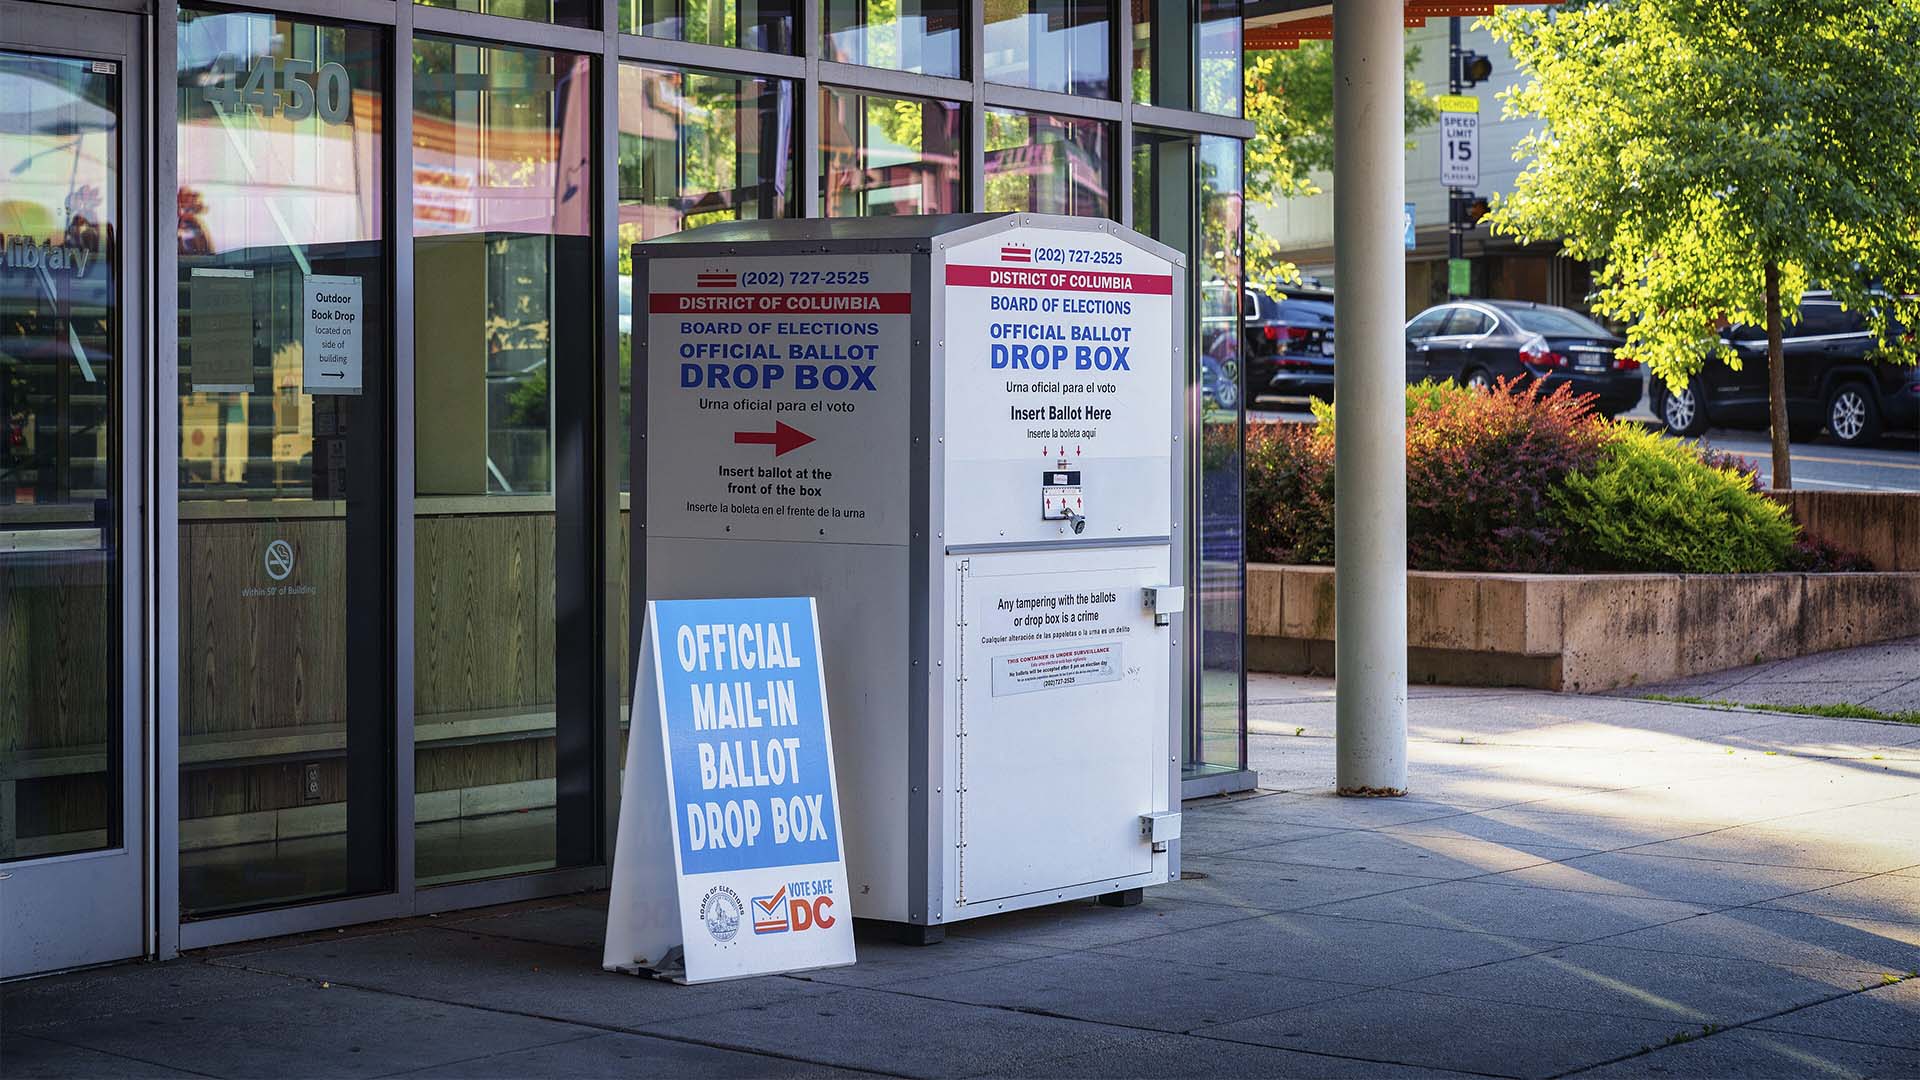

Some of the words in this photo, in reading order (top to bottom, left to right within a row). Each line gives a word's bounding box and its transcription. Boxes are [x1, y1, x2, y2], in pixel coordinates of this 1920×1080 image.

[203, 51, 351, 126] 4450
[1444, 117, 1476, 128] SPEED
[1447, 128, 1472, 138] LIMIT
[1448, 140, 1472, 161] 15
[7, 234, 89, 278] library
[1034, 247, 1065, 264] (202)
[1068, 249, 1122, 265] 727-2525
[742, 271, 785, 288] (202)
[790, 271, 869, 285] 727-2525
[990, 270, 1047, 286] DISTRICT
[1050, 273, 1066, 287] OF
[1069, 274, 1132, 290] COLUMBIA
[316, 292, 351, 304] Outdoor
[679, 296, 755, 310] DISTRICT
[759, 297, 782, 310] OF
[786, 296, 881, 310] COLUMBIA
[990, 295, 1038, 312] BOARD
[1042, 297, 1059, 313] OF
[1063, 298, 1131, 315] ELECTIONS
[311, 309, 332, 320] Book
[335, 310, 355, 323] Drop
[315, 325, 340, 335] located
[342, 327, 351, 335] on
[680, 322, 742, 335] BOARD
[748, 322, 772, 335] OF
[777, 322, 879, 336] ELECTIONS
[990, 323, 1065, 341] OFFICIAL
[1071, 325, 1132, 342] BALLOT
[322, 340, 336, 349] side
[337, 340, 345, 349] of
[680, 343, 781, 360] OFFICIAL
[789, 344, 879, 361] BALLOT
[320, 354, 348, 365] building
[991, 343, 1068, 370] DROP
[1075, 345, 1130, 371] BOX
[680, 363, 785, 390] DROP
[795, 364, 877, 391] BOX
[1006, 381, 1029, 393] Urna
[1031, 381, 1060, 393] oficial
[1062, 383, 1084, 395] para
[1086, 382, 1095, 393] el
[1097, 383, 1116, 393] voto
[699, 398, 729, 411] Urna
[733, 398, 772, 411] oficial
[776, 401, 806, 414] para
[810, 399, 822, 412] el
[826, 401, 855, 413] voto
[1011, 405, 1045, 421] Insert
[1049, 405, 1082, 420] Ballot
[1085, 405, 1112, 420] Here
[1027, 428, 1051, 439] Inserte
[1051, 428, 1058, 439] la
[1059, 427, 1080, 439] boleta
[1081, 427, 1096, 440] aquí
[719, 465, 754, 478] Insert
[758, 466, 792, 479] ballot
[796, 468, 808, 479] at
[812, 468, 832, 480] the
[727, 482, 756, 494] front
[760, 482, 773, 495] of
[776, 484, 796, 496] the
[799, 484, 822, 497] box
[687, 502, 718, 513] Inserte
[720, 502, 729, 513] la
[731, 503, 760, 514] boleta
[762, 506, 774, 515] en
[776, 504, 785, 515] el
[787, 505, 815, 517] frente
[817, 506, 829, 517] de
[832, 507, 840, 518] la
[843, 509, 865, 518] urna
[997, 598, 1014, 613] Any
[1016, 595, 1056, 610] tampering
[1058, 594, 1075, 606] with
[1076, 593, 1089, 605] the
[1091, 591, 1116, 604] ballots
[1013, 616, 1022, 627] or
[1024, 613, 1043, 627] drop
[1045, 612, 1060, 624] box
[1061, 612, 1069, 623] is
[1071, 613, 1076, 622] a
[1077, 610, 1099, 622] crime
[677, 622, 801, 672] OFFICIAL
[1007, 656, 1019, 664] THIS
[1020, 654, 1049, 663] CONTAINER
[1056, 651, 1073, 659] UNDER
[1074, 647, 1110, 657] SURVEILLANCE
[690, 680, 798, 731] MAIL-IN
[698, 738, 801, 791] BALLOT
[686, 799, 761, 851] DROP
[770, 794, 828, 844] BOX
[788, 881, 811, 898] VOTE
[812, 879, 834, 896] SAFE
[700, 893, 711, 920] BOARD
[710, 886, 717, 895] OF
[719, 885, 745, 916] ELECTIONS
[789, 895, 836, 932] DC
